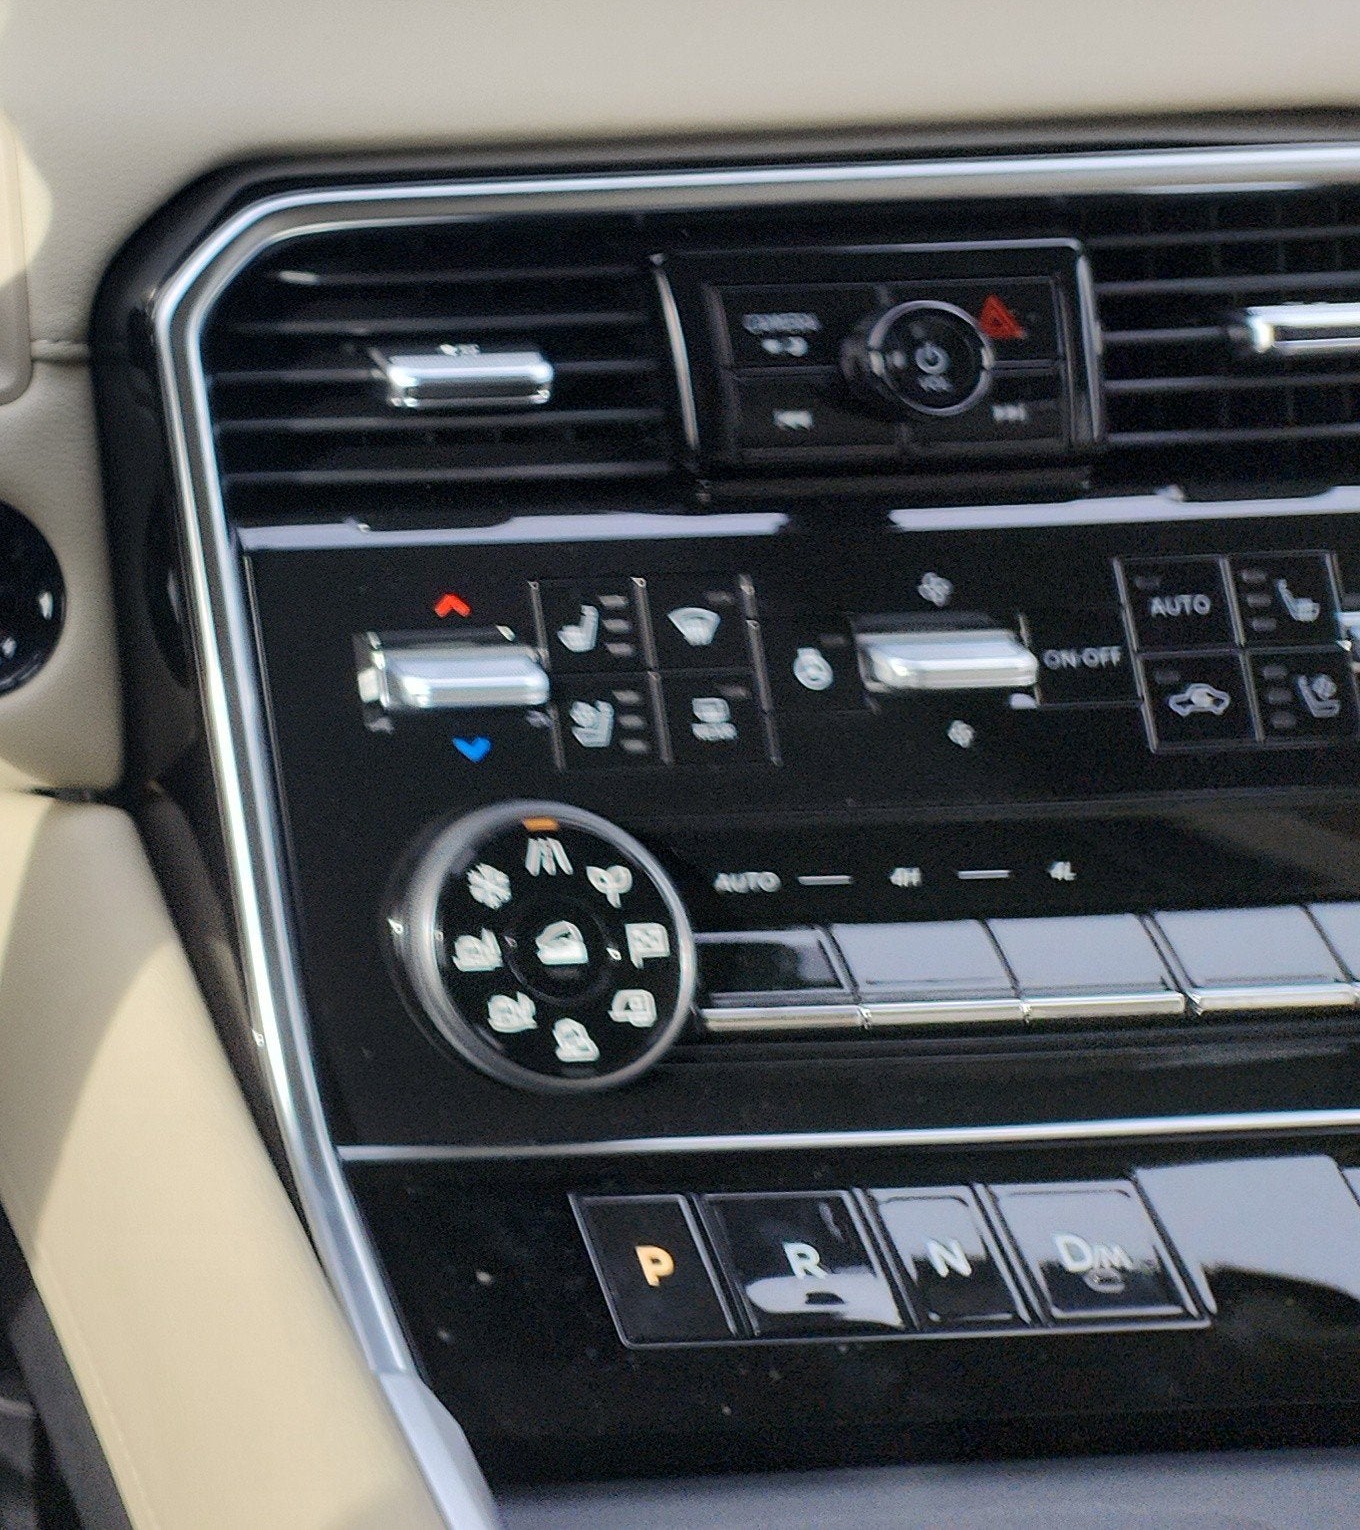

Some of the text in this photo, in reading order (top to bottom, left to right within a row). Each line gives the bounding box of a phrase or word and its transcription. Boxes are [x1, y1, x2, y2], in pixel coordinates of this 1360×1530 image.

[1150, 593, 1211, 617] AUTO
[713, 871, 780, 894] AUTO
[634, 1245, 674, 1287] P
[783, 1242, 828, 1281] R
[928, 1238, 972, 1278] N
